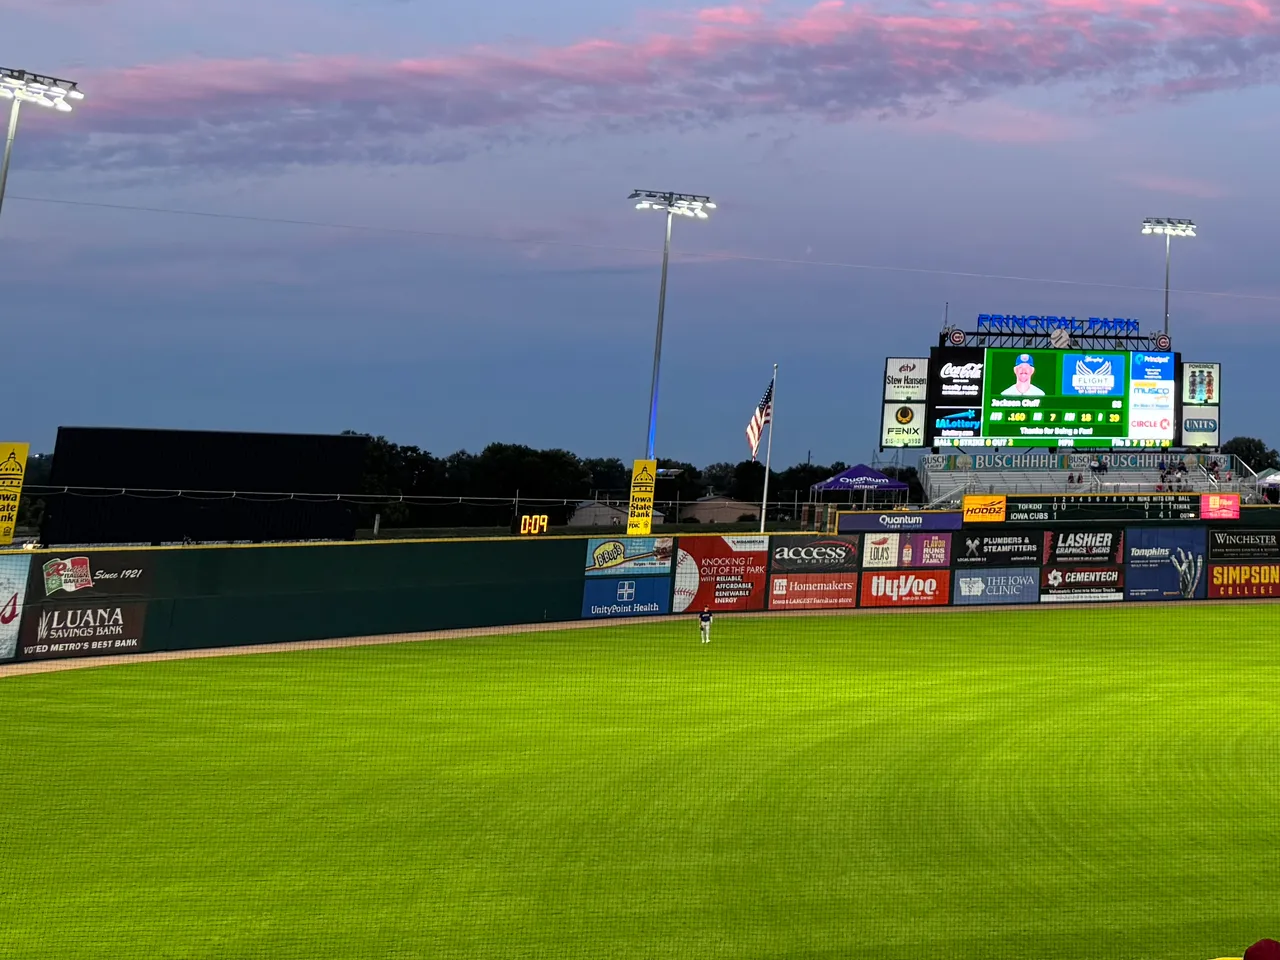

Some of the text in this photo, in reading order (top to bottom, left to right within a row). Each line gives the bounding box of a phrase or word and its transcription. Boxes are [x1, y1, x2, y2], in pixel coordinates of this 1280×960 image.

[978, 314, 1139, 331] PRINCIPAL PARK
[886, 375, 926, 385] Stew Hansen
[1186, 420, 1214, 428] UNITS
[923, 456, 946, 464] BUSCH
[521, 515, 548, 534] 0:09
[879, 515, 922, 525] Quantum
[1215, 533, 1276, 544] WINCHESTER
[775, 546, 846, 559] access
[870, 547, 890, 560] LOLA'S
[1130, 548, 1170, 558] Tompkins
[702, 558, 745, 566] KNOCKING
[94, 569, 142, 579] Since 1921
[1066, 571, 1118, 582] CEMENTECH
[1213, 566, 1280, 585] SIMPSON
[986, 576, 1034, 585] THE IOWA
[789, 581, 852, 591] Homemakers
[986, 586, 1022, 595] CLINIC
[1220, 586, 1272, 595] COLLEGE
[592, 602, 659, 615] UnityPoint Health
[51, 608, 123, 628] LUANA
[50, 626, 123, 638] SAVINGS BANK
[24, 645, 48, 654] VOTED
[50, 642, 89, 652] METRO'S
[115, 639, 137, 647] BANK
